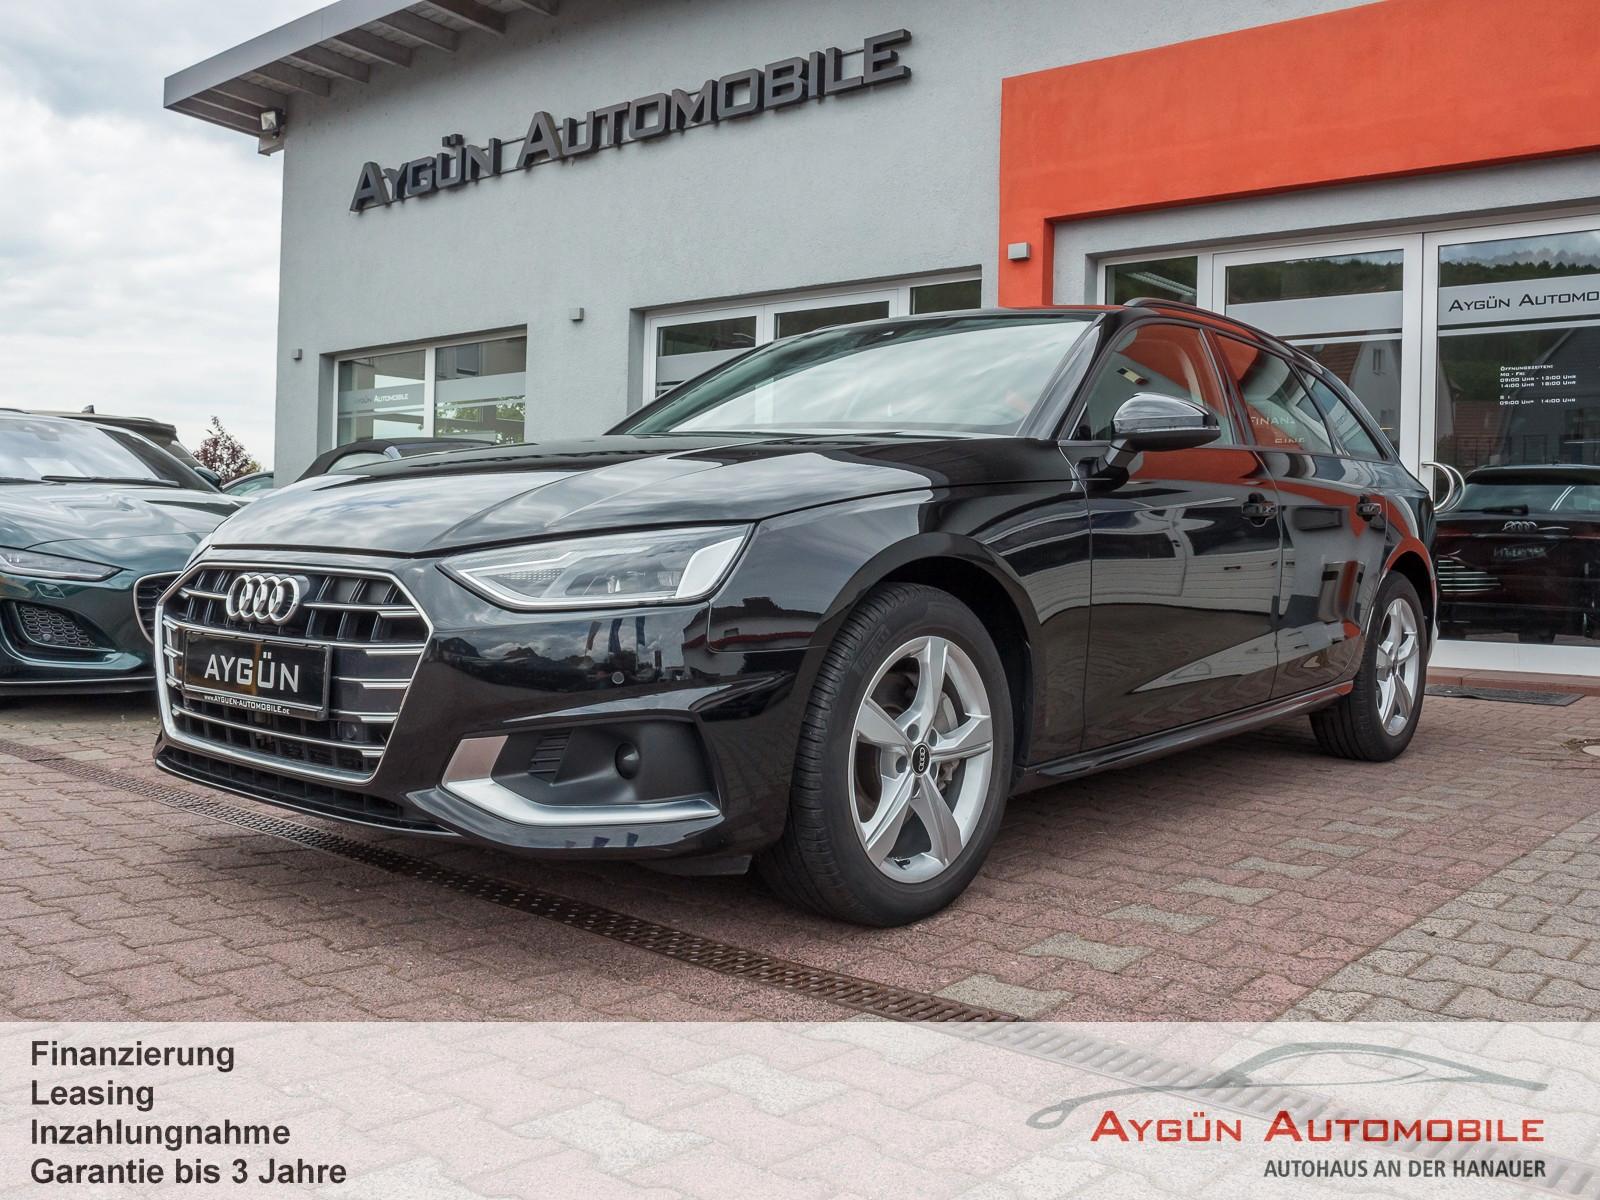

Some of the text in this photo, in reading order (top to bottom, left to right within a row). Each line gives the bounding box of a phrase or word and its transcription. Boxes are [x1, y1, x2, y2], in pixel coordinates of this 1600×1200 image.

[350, 28, 912, 212] AYGÜN AUTOMOBILE
[1448, 291, 1600, 312] AYGÜN AUTOMO
[204, 651, 299, 693] AYGÜN
